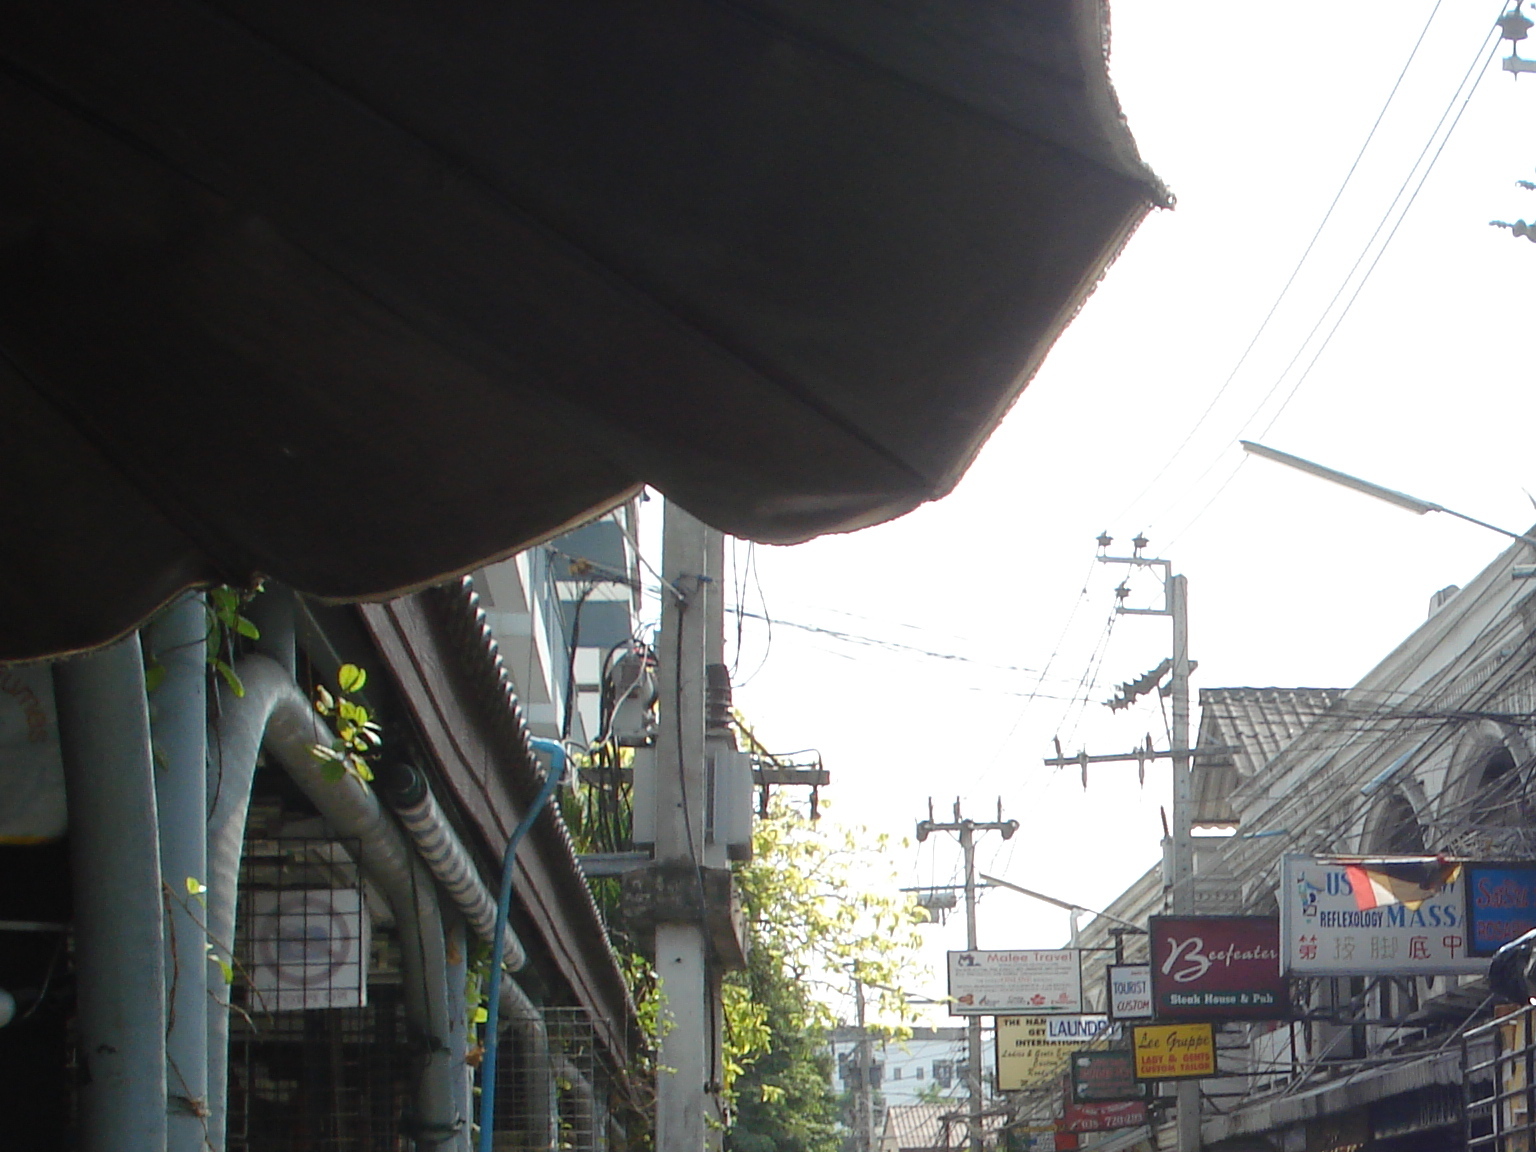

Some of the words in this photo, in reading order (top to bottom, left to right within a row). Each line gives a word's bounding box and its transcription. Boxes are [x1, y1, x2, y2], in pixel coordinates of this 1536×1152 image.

[1320, 909, 1384, 928] REFLEXOLOGY
[1387, 904, 1464, 928] MASS
[987, 953, 1028, 963] Malee
[1034, 951, 1072, 961] Travel
[1161, 936, 1278, 983] Beefeater
[1114, 981, 1146, 995] TOURIST
[1171, 993, 1200, 1005] Steak
[1205, 993, 1236, 1005] House
[1241, 994, 1248, 1004] &
[1253, 993, 1273, 1004] Pub
[1180, 1062, 1210, 1071] TAILOR
